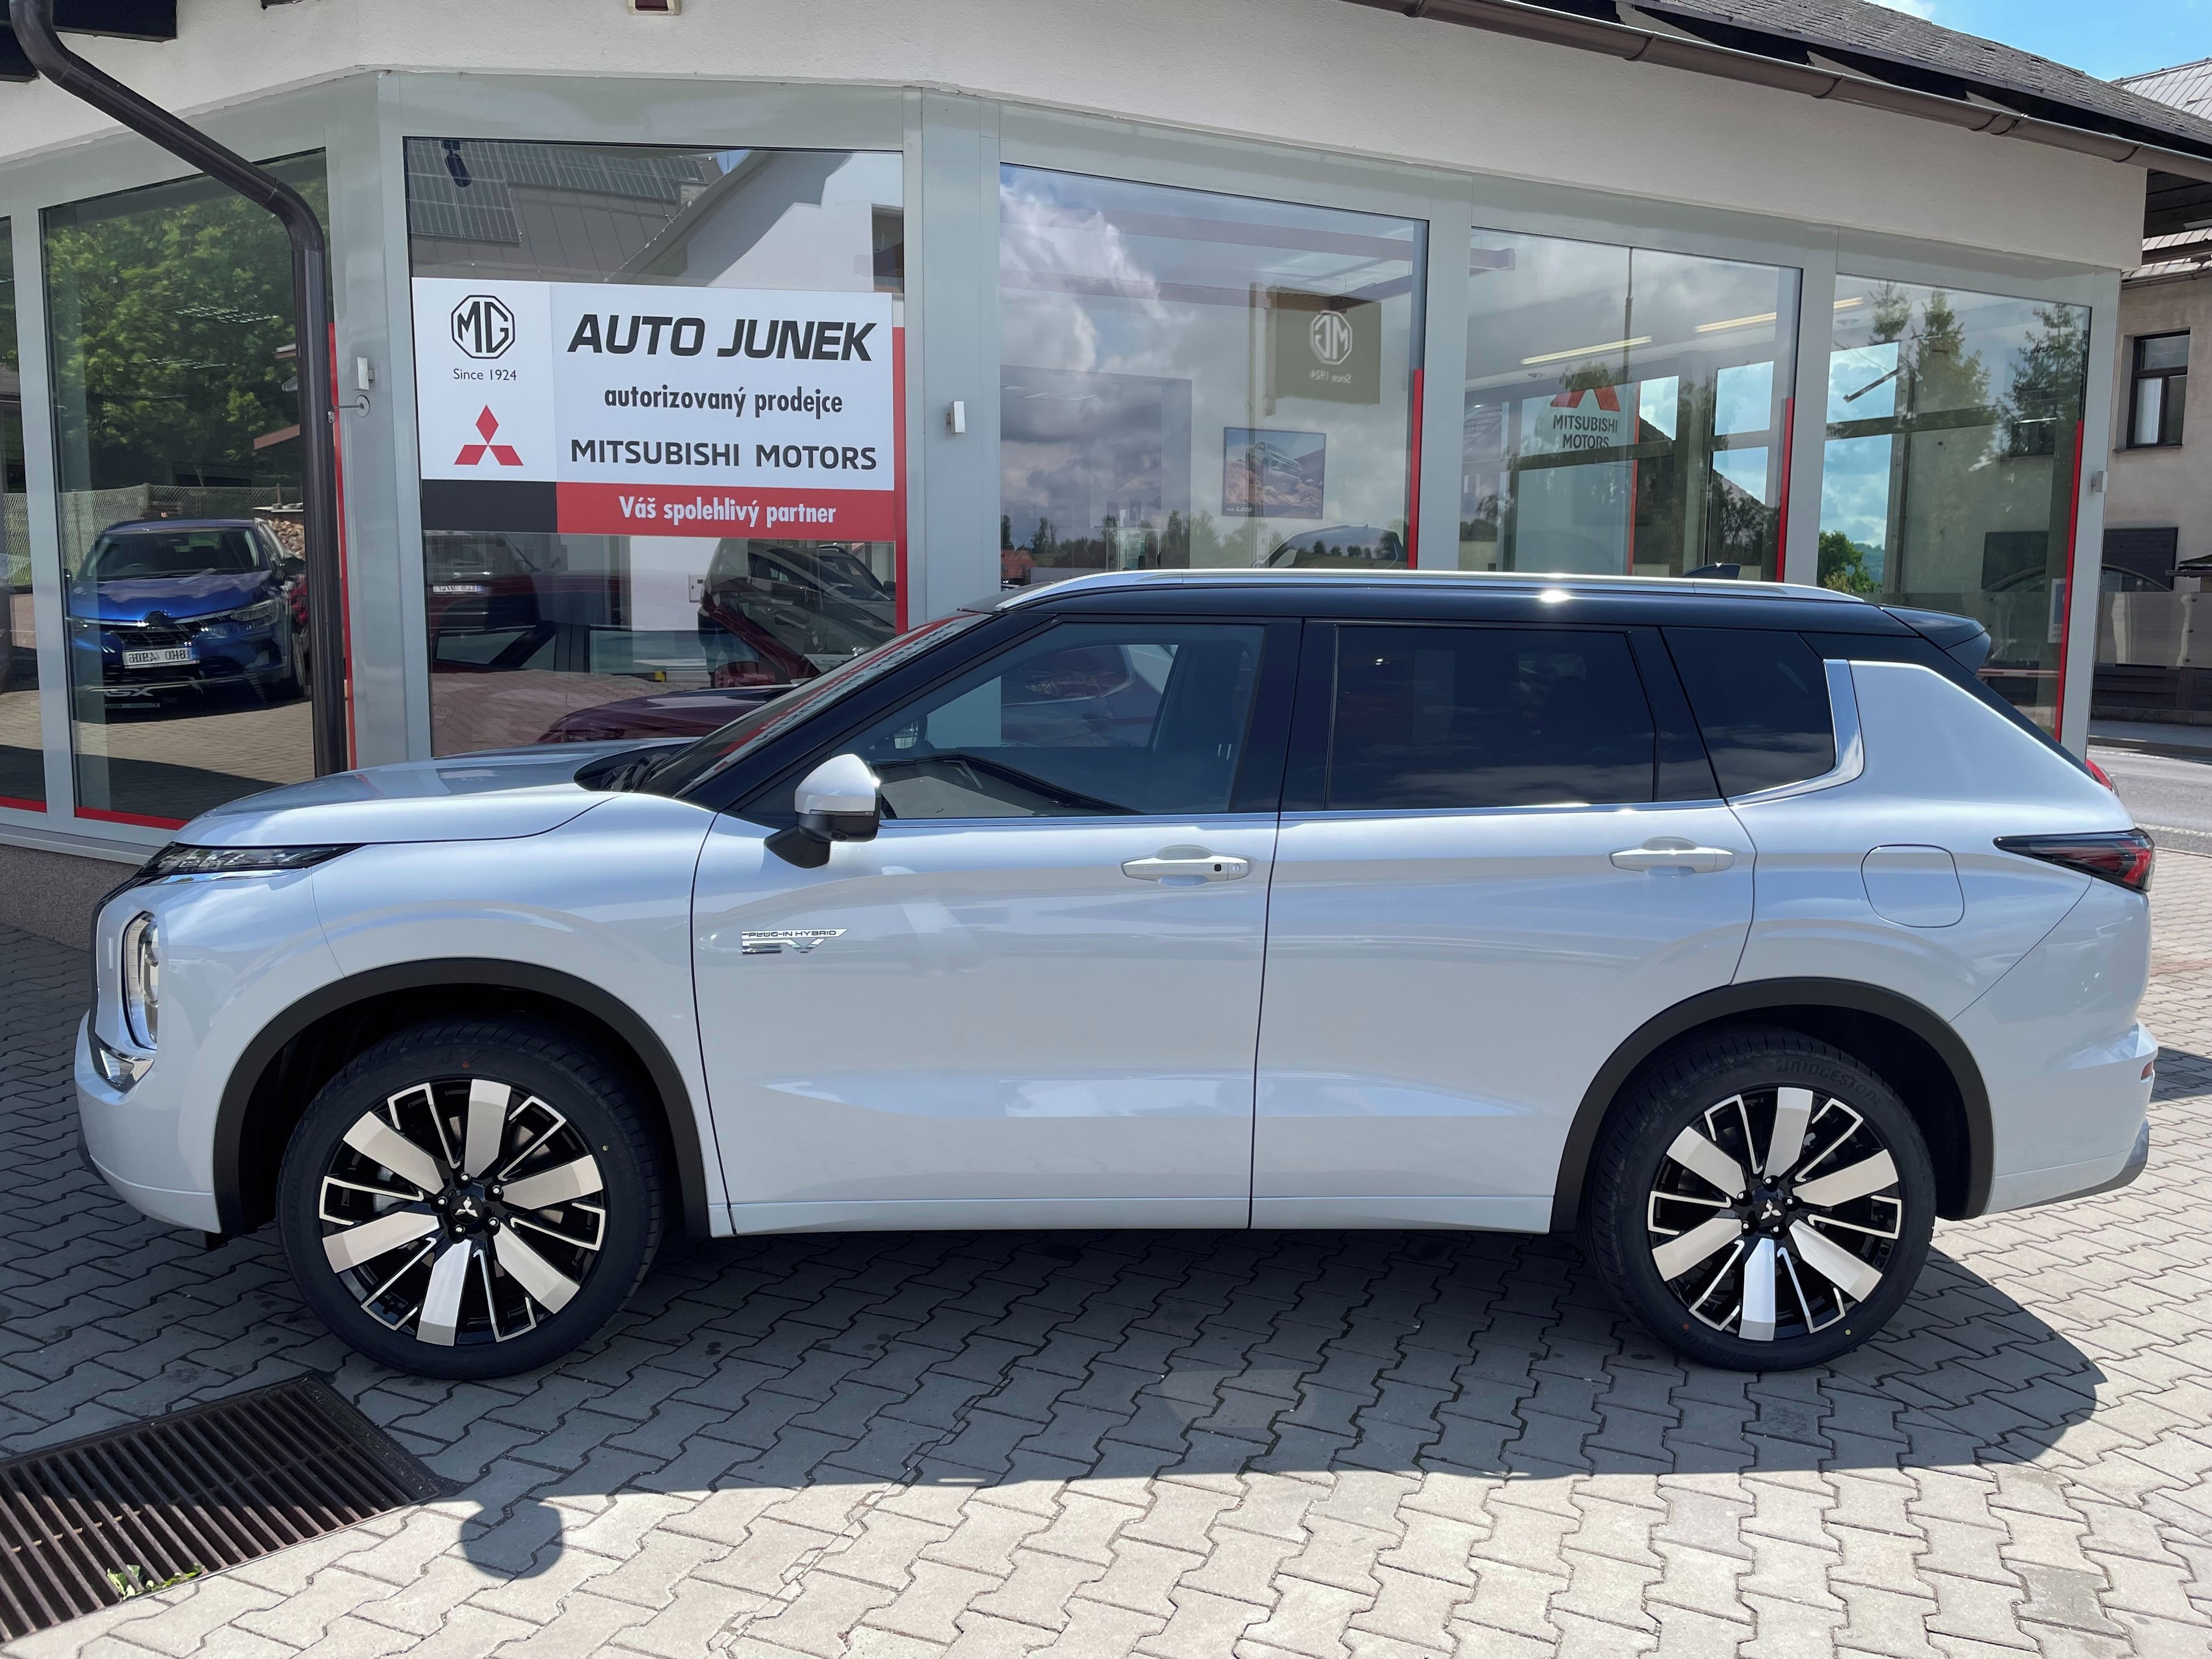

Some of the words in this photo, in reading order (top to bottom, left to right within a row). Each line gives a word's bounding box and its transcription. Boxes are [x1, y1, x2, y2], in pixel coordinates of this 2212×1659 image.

[457, 301, 509, 353] MG
[567, 314, 706, 357] AUTO
[717, 319, 877, 362] JUNEK
[454, 369, 484, 380] Since
[490, 369, 517, 381] 1924
[604, 385, 746, 417] autorizovaný
[755, 386, 843, 419] prodejce
[1553, 414, 1618, 433] MITSUBISHI
[571, 439, 740, 466] MITSUBISHI
[756, 445, 877, 470] MOTORS
[1562, 434, 1610, 449] MOTORS
[618, 496, 656, 518] Váš
[663, 497, 760, 527] spolehlivý
[766, 504, 836, 528] partner
